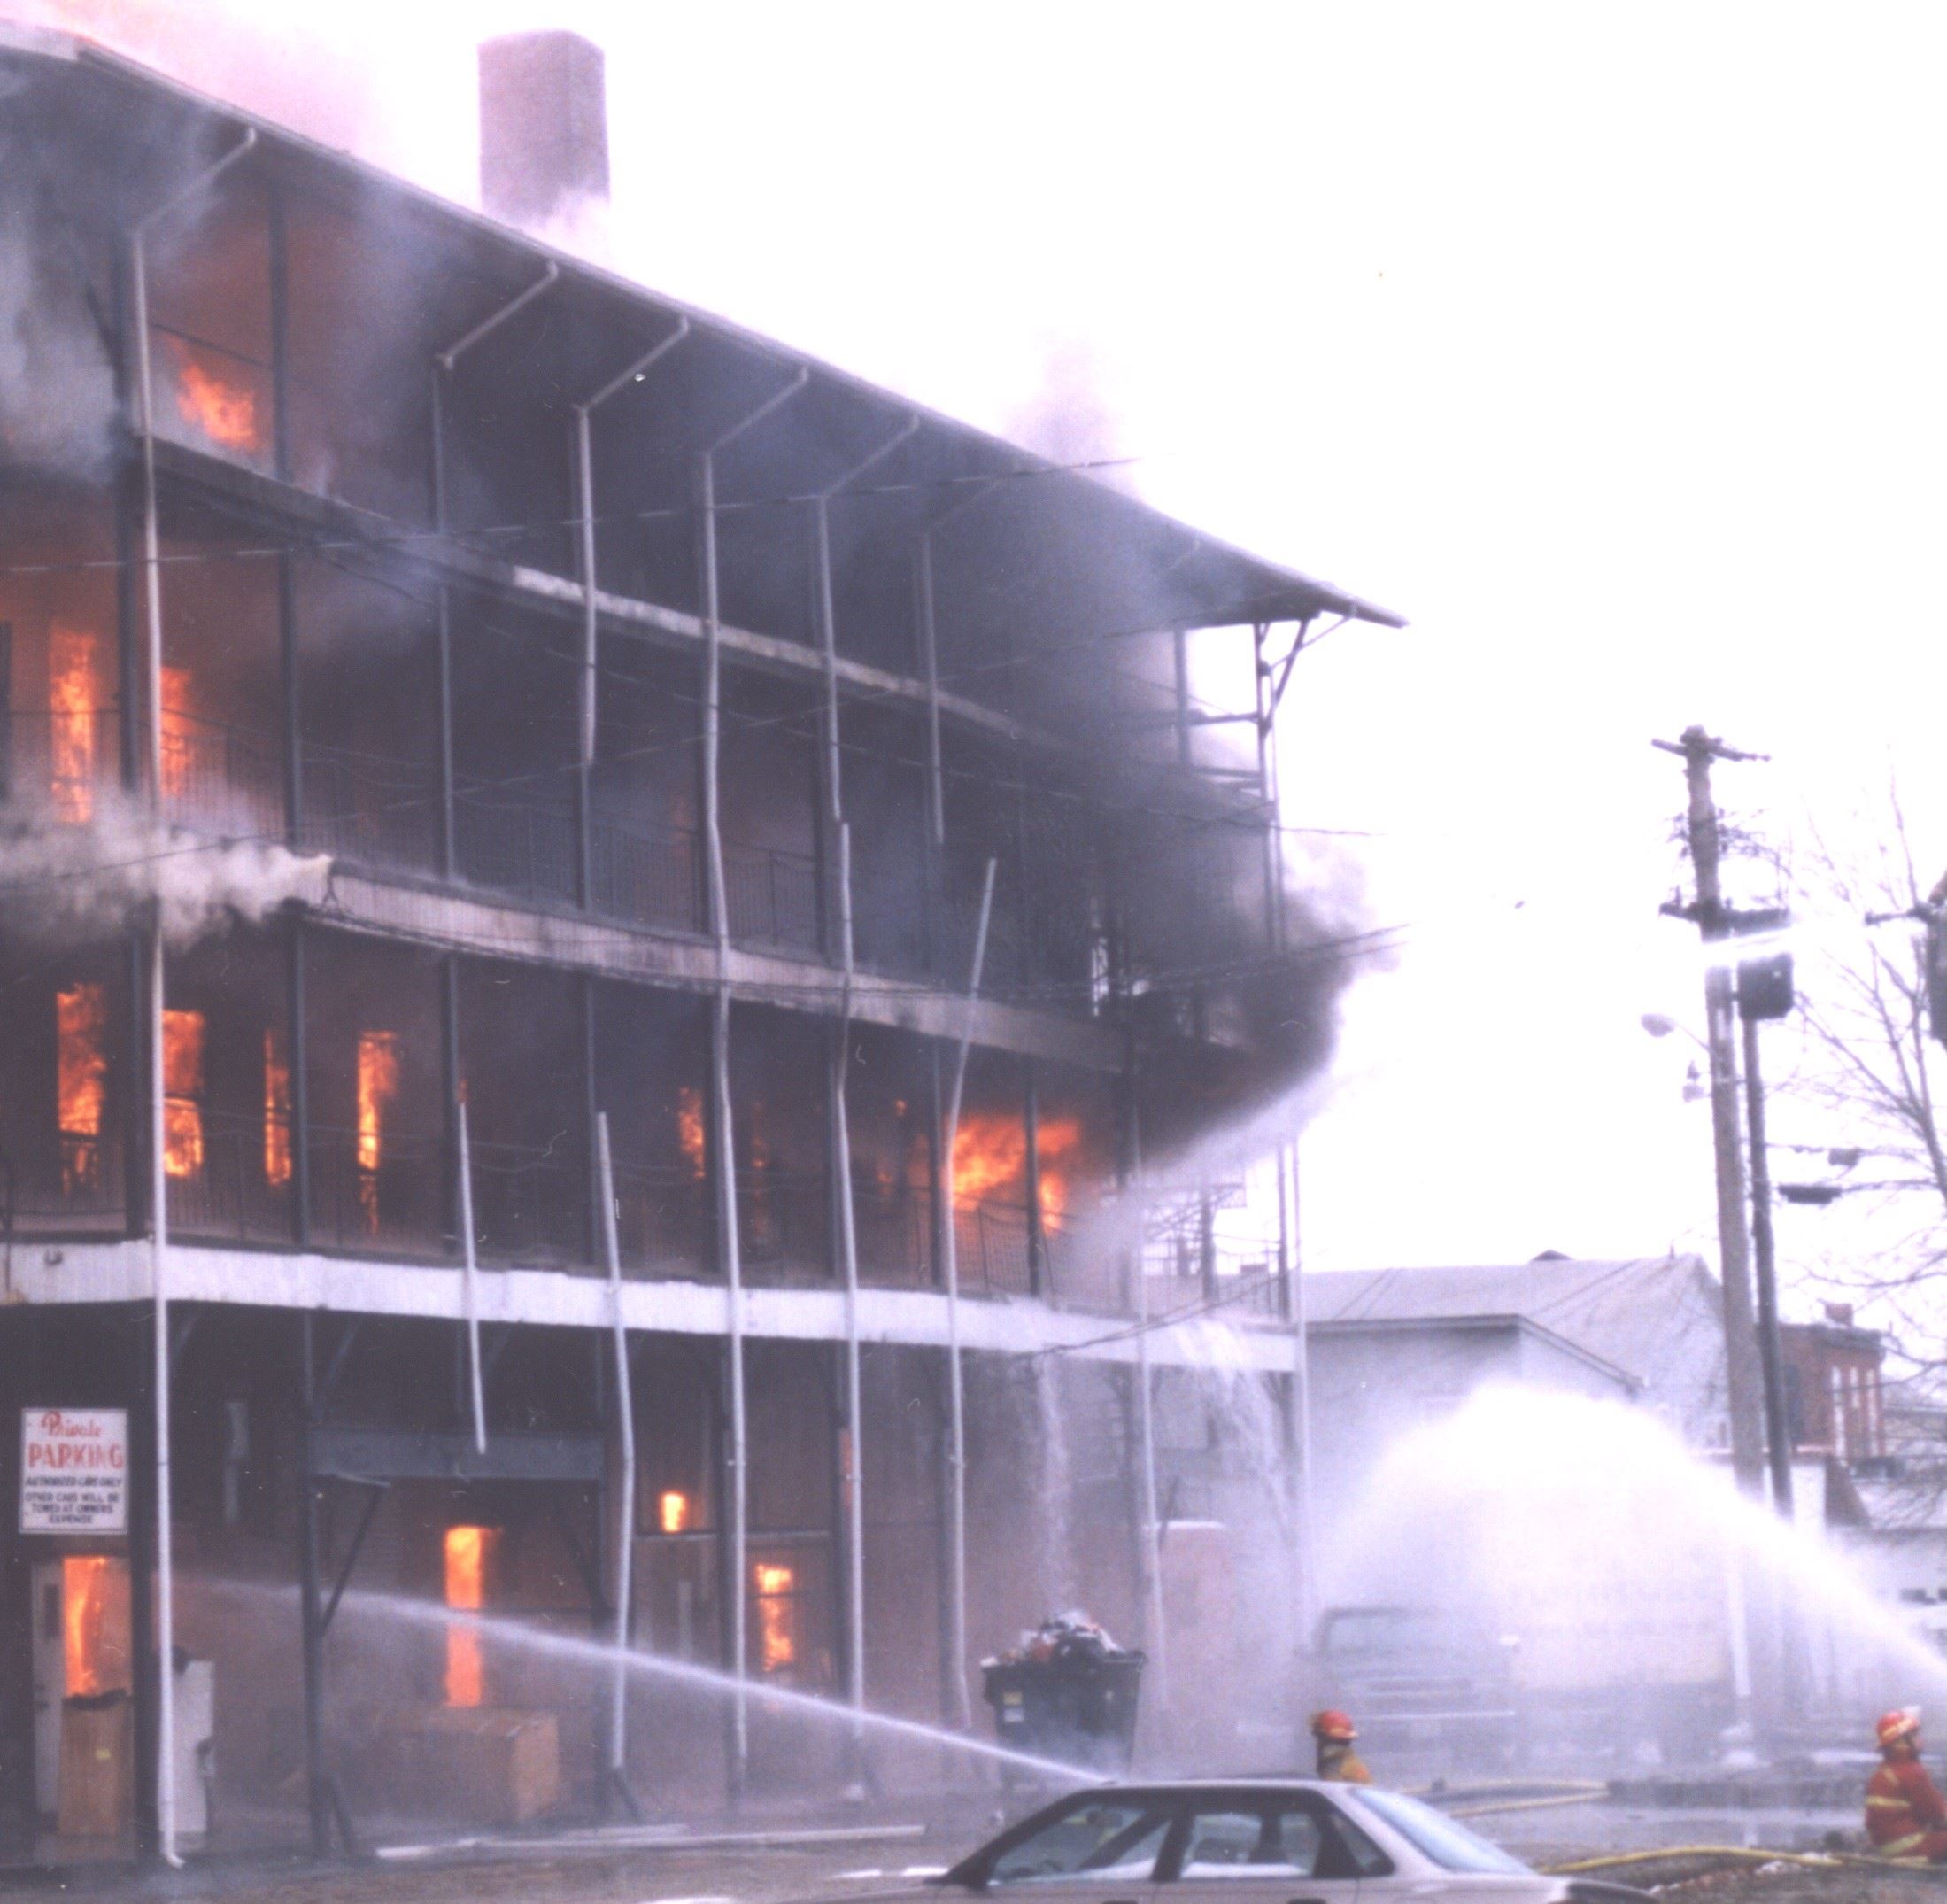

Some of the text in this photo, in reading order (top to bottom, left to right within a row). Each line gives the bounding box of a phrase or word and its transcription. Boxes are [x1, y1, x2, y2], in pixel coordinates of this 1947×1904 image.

[41, 1410, 102, 1436] Private
[28, 1443, 124, 1469] PARKING
[25, 1492, 120, 1503] OTHER CARS WILL BE
[32, 1504, 60, 1514] TOWED
[62, 1504, 73, 1514] AT
